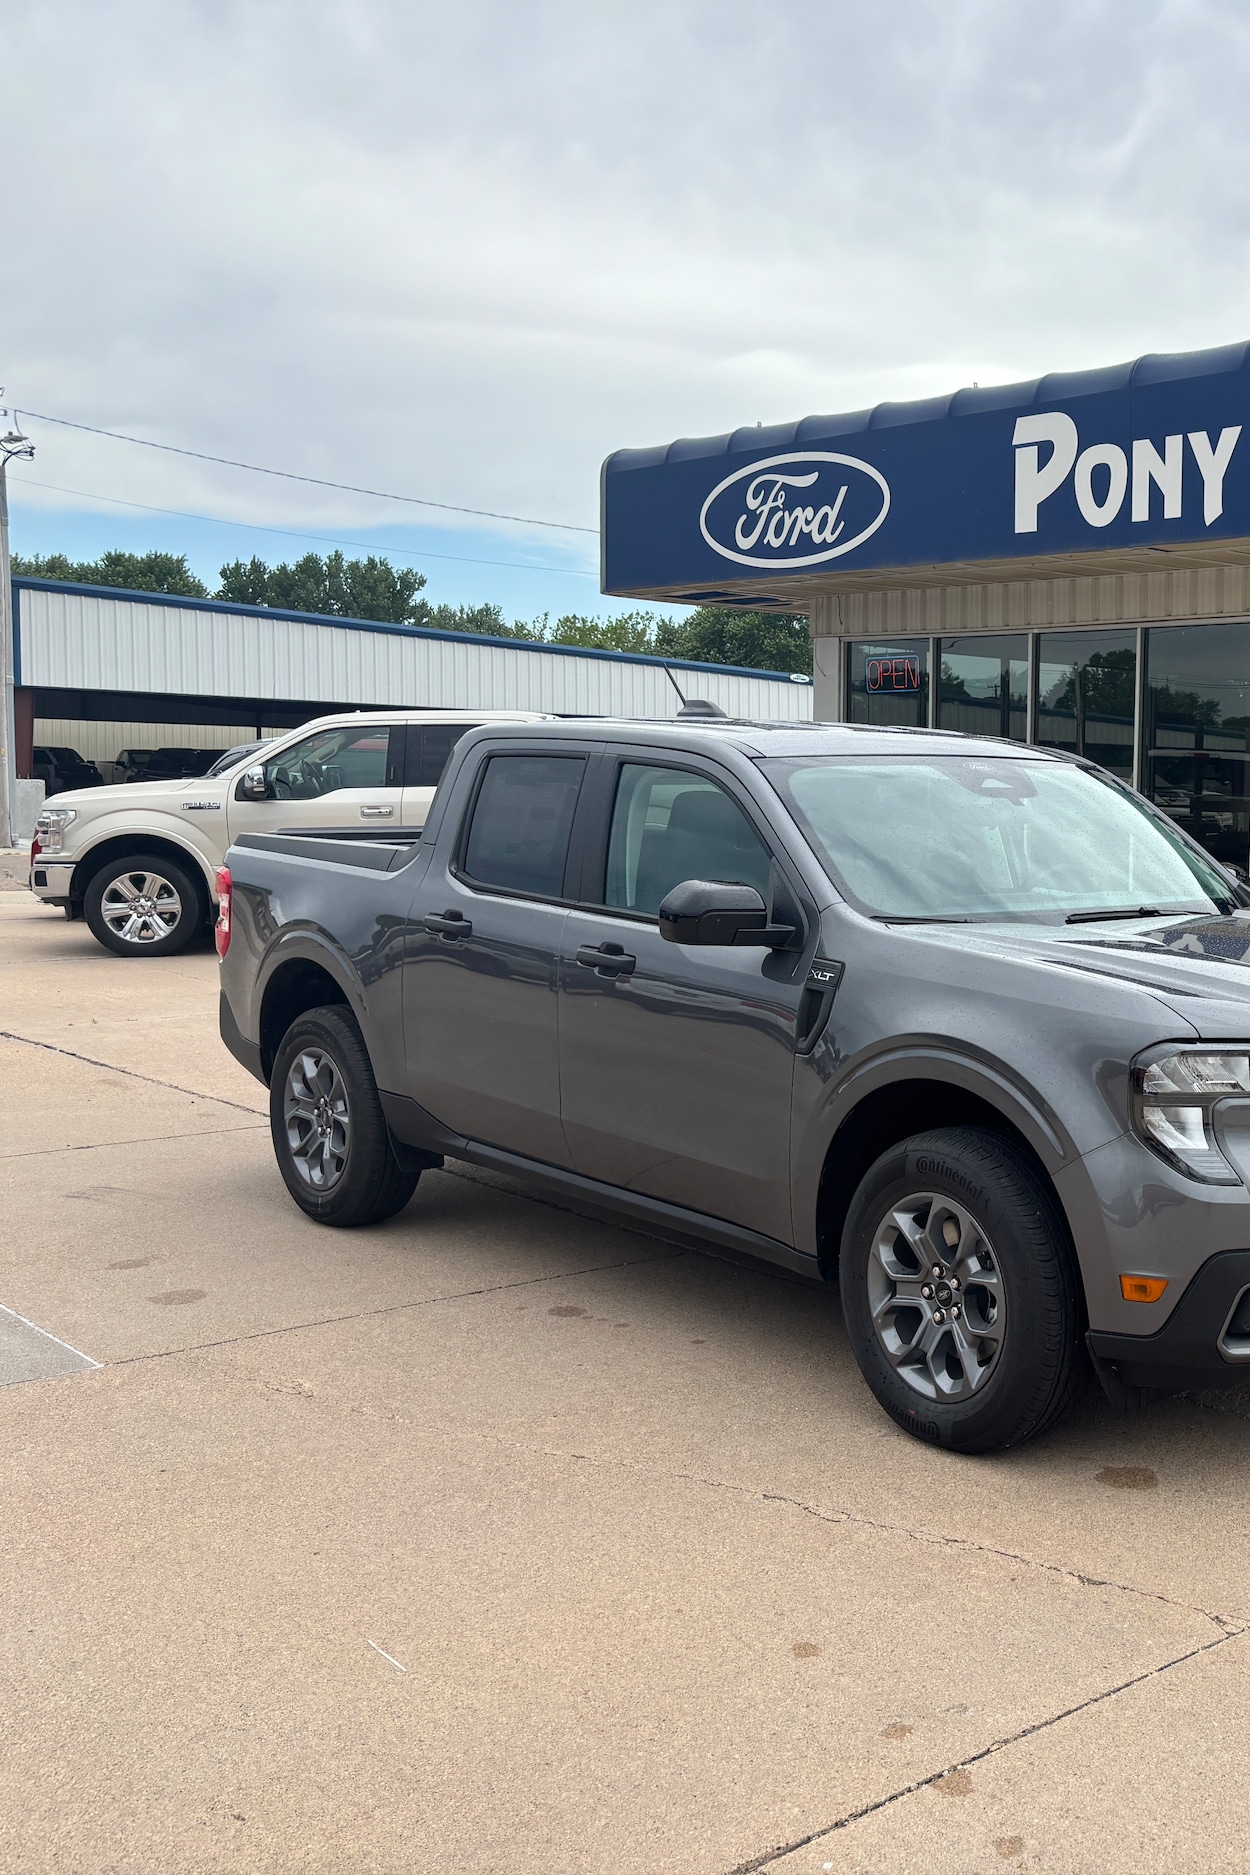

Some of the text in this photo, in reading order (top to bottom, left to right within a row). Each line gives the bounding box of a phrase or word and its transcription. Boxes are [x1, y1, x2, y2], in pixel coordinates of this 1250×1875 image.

[1011, 411, 1243, 528] PONY
[735, 471, 849, 550] Ford
[868, 659, 918, 690] OPEN
[809, 969, 835, 981] XLT
[916, 1155, 985, 1201] Continental
